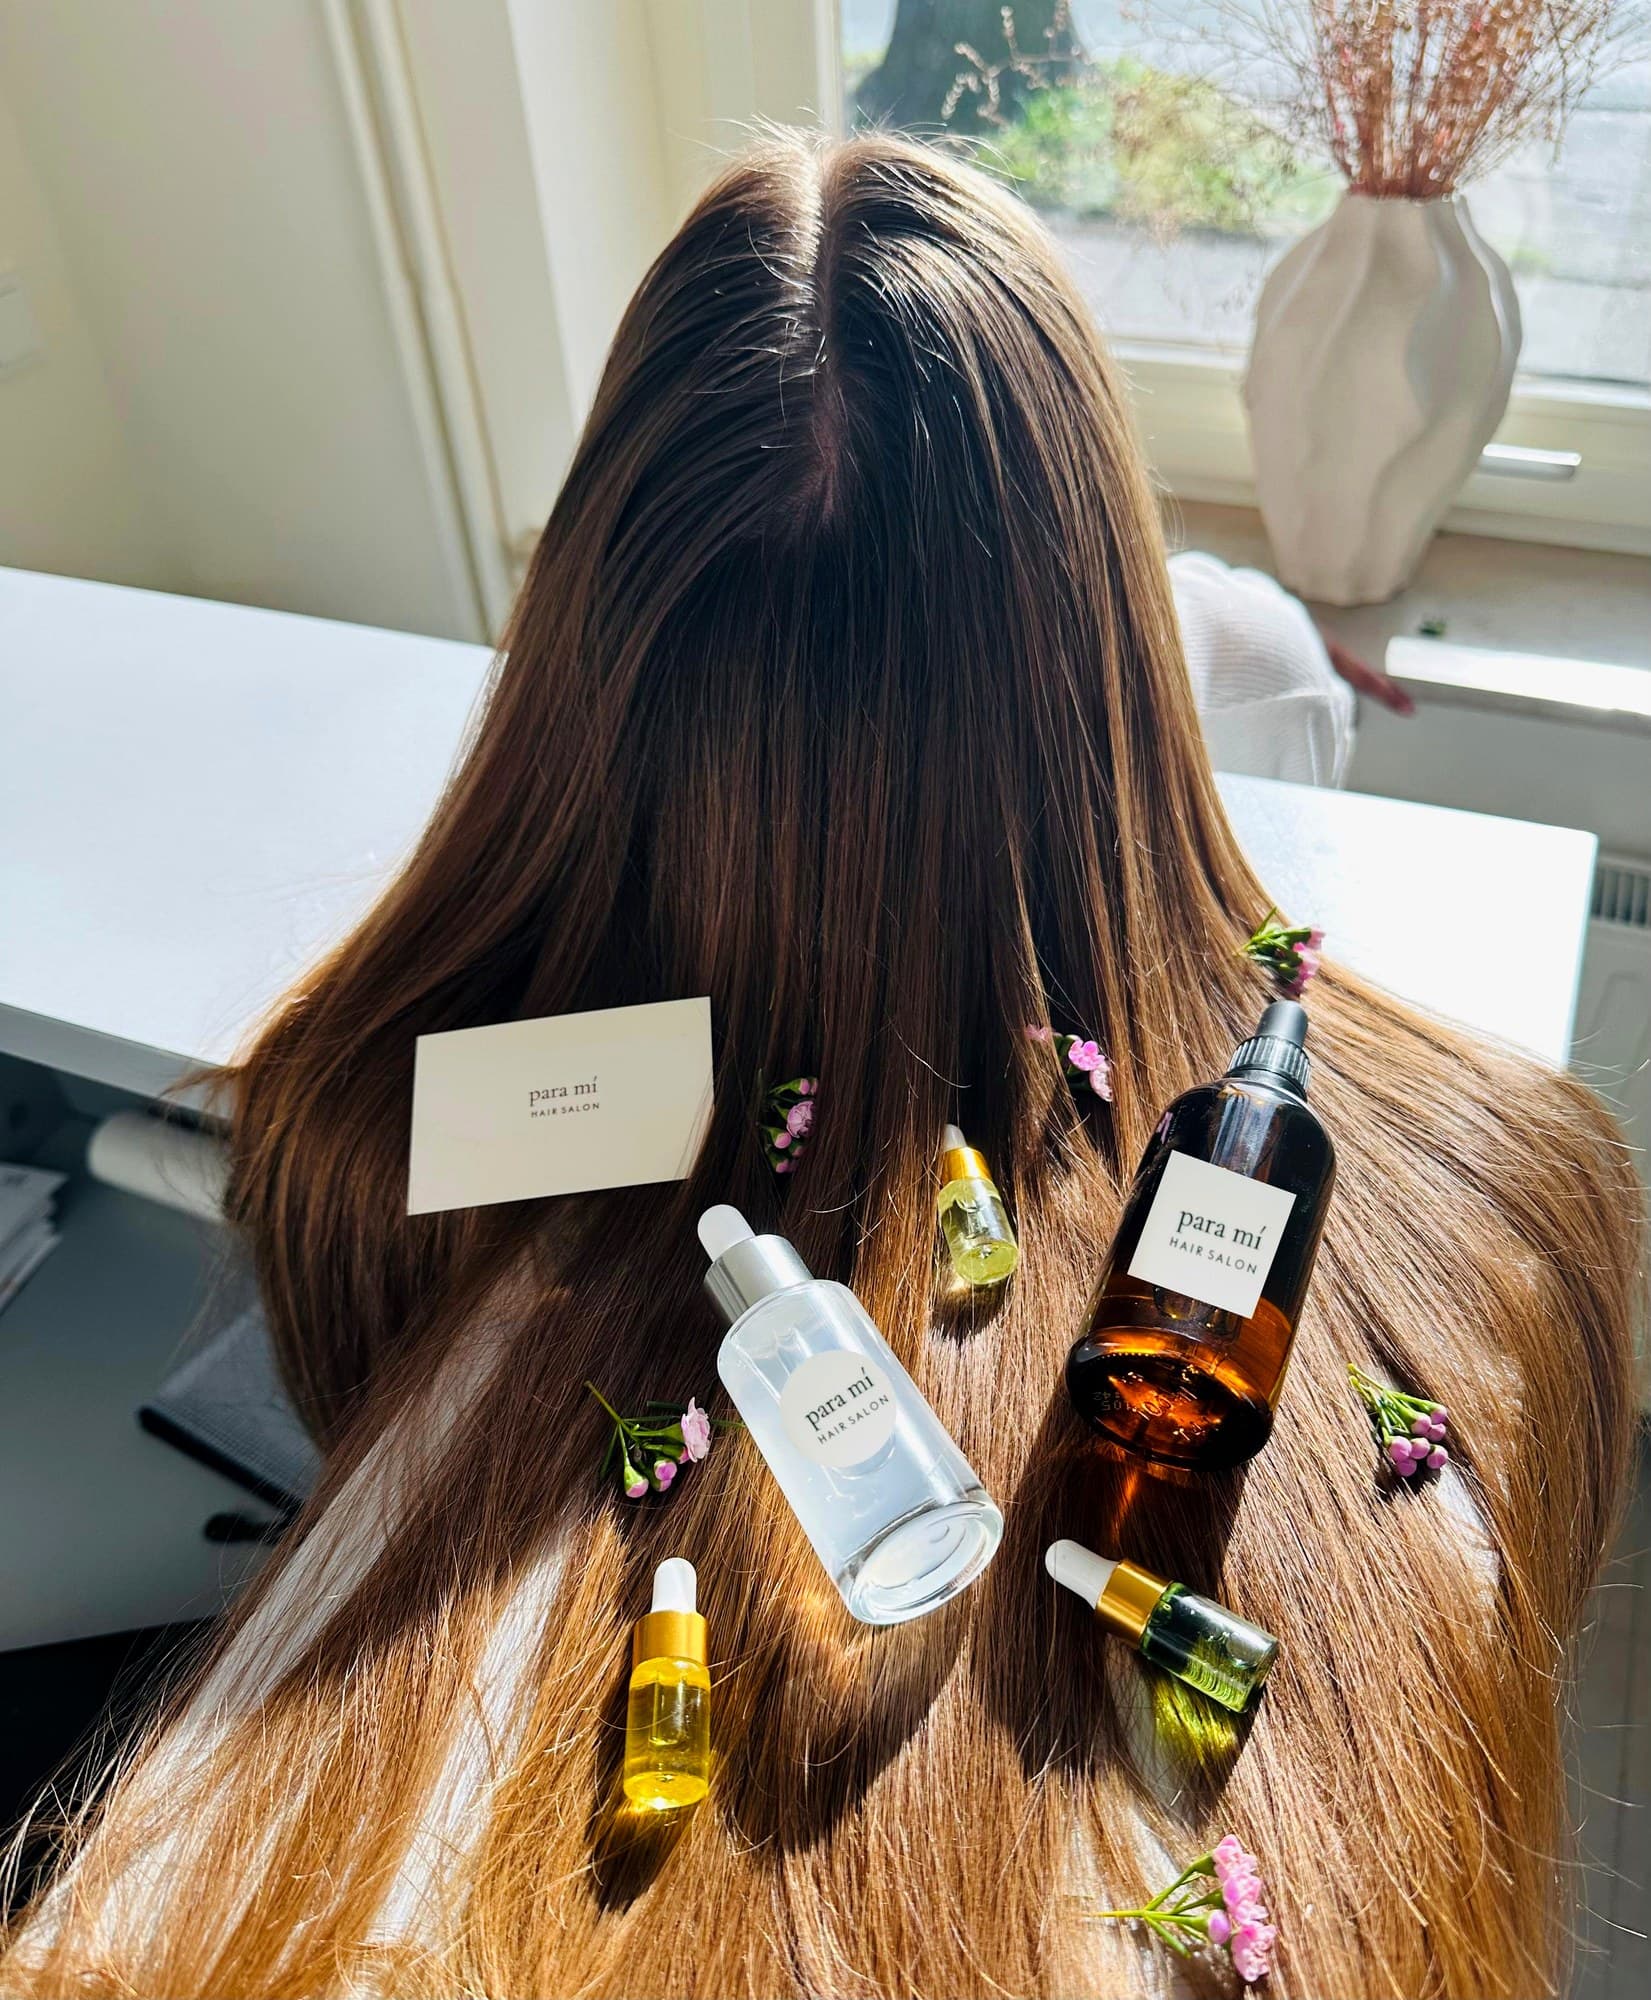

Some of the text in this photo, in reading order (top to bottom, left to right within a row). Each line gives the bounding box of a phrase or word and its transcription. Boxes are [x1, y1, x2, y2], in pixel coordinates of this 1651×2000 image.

[529, 1075, 598, 1107] para mí
[531, 1103, 600, 1118] HAIR SALON
[1176, 1210, 1267, 1250] para mí
[1169, 1236, 1258, 1275] HAIR SALON
[805, 1366, 874, 1432] para mí
[817, 1394, 889, 1445] HAIR SALON
